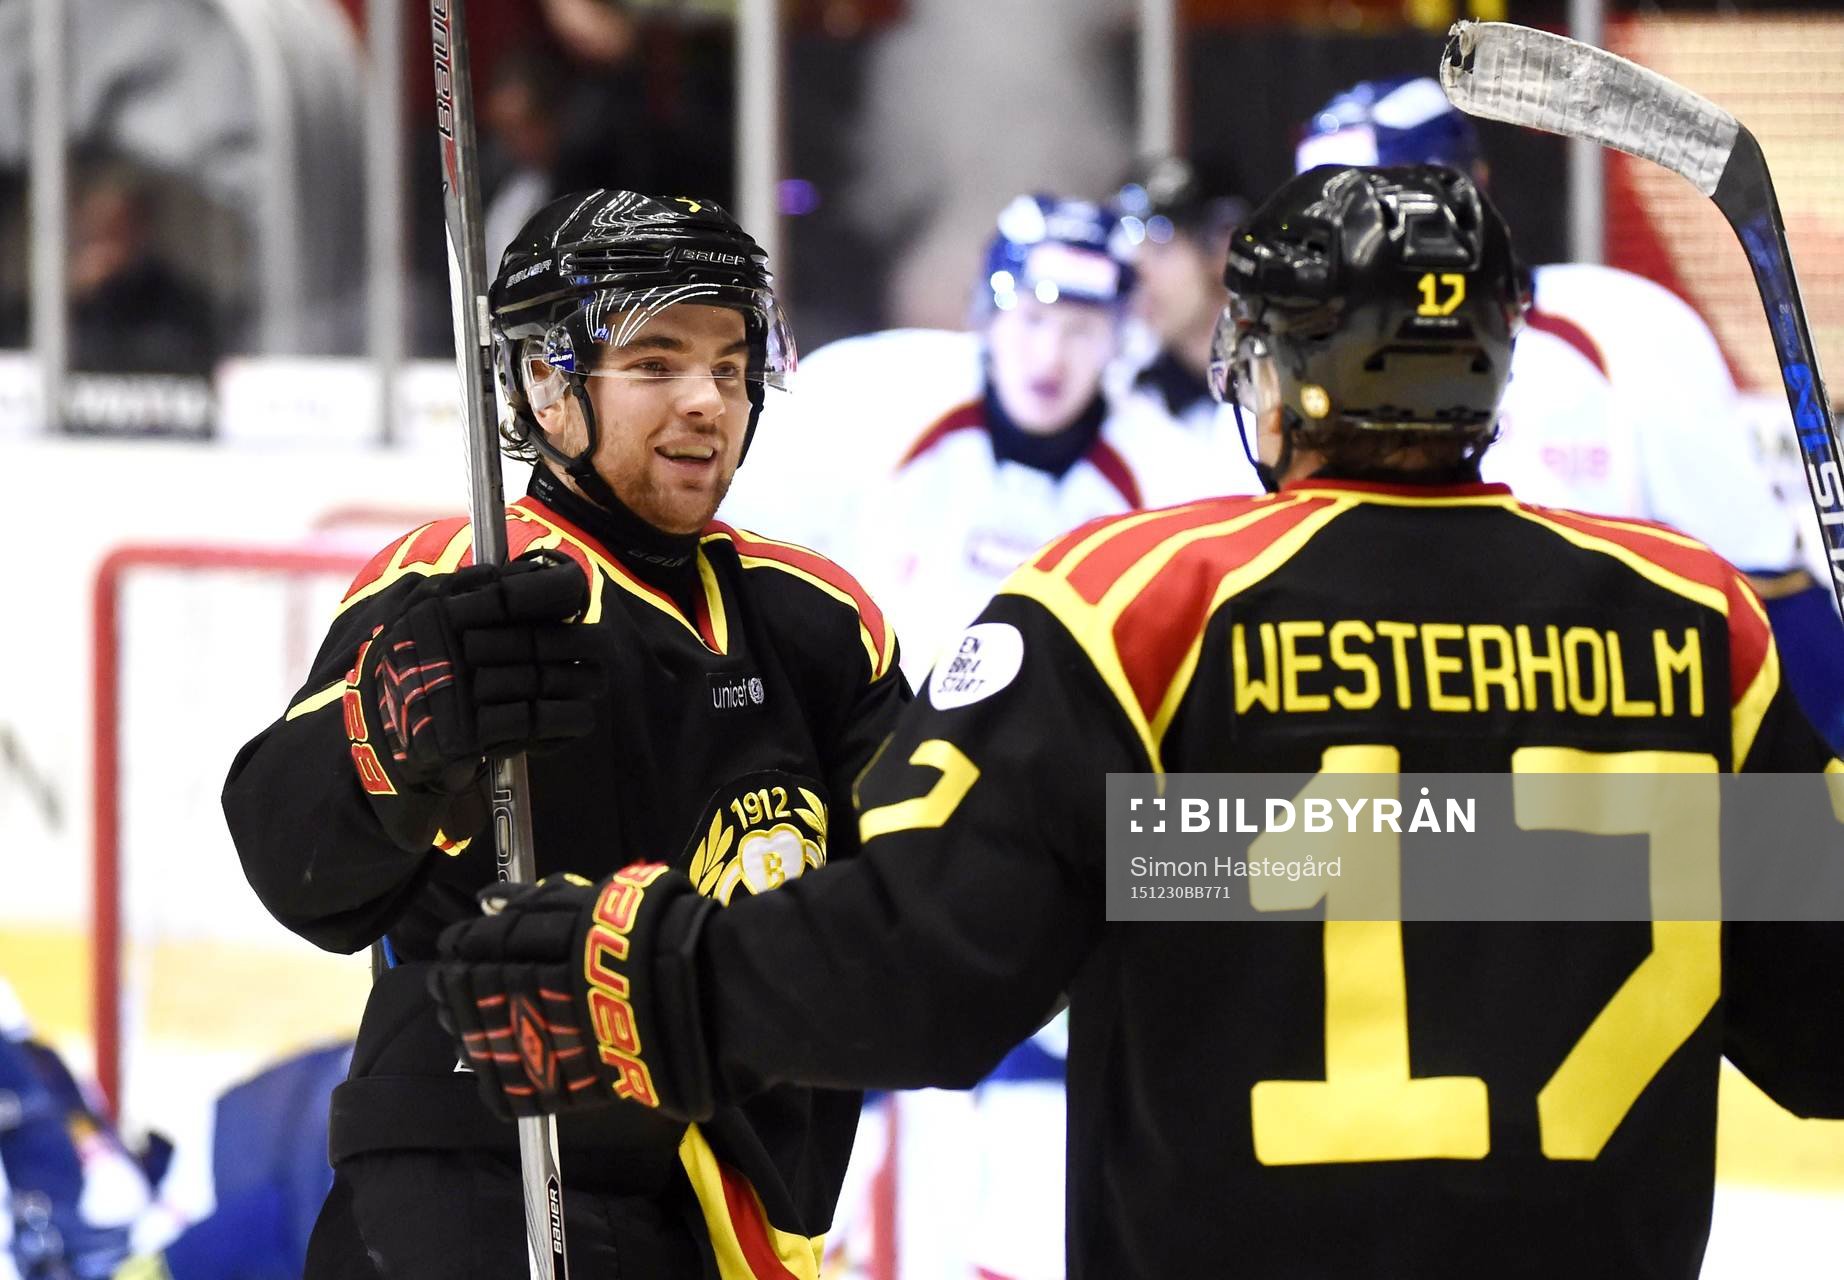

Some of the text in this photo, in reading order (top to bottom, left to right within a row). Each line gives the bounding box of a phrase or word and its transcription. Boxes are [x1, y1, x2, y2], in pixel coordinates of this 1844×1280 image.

[1417, 272, 1466, 317] 17
[959, 636, 981, 654] EN
[1233, 620, 1705, 717] WESTERHOLM
[712, 676, 748, 709] unicef
[730, 786, 792, 830] 1912
[1247, 744, 1722, 1167] 17
[584, 859, 670, 1108] BAUER
[549, 1188, 562, 1254] BAUER
